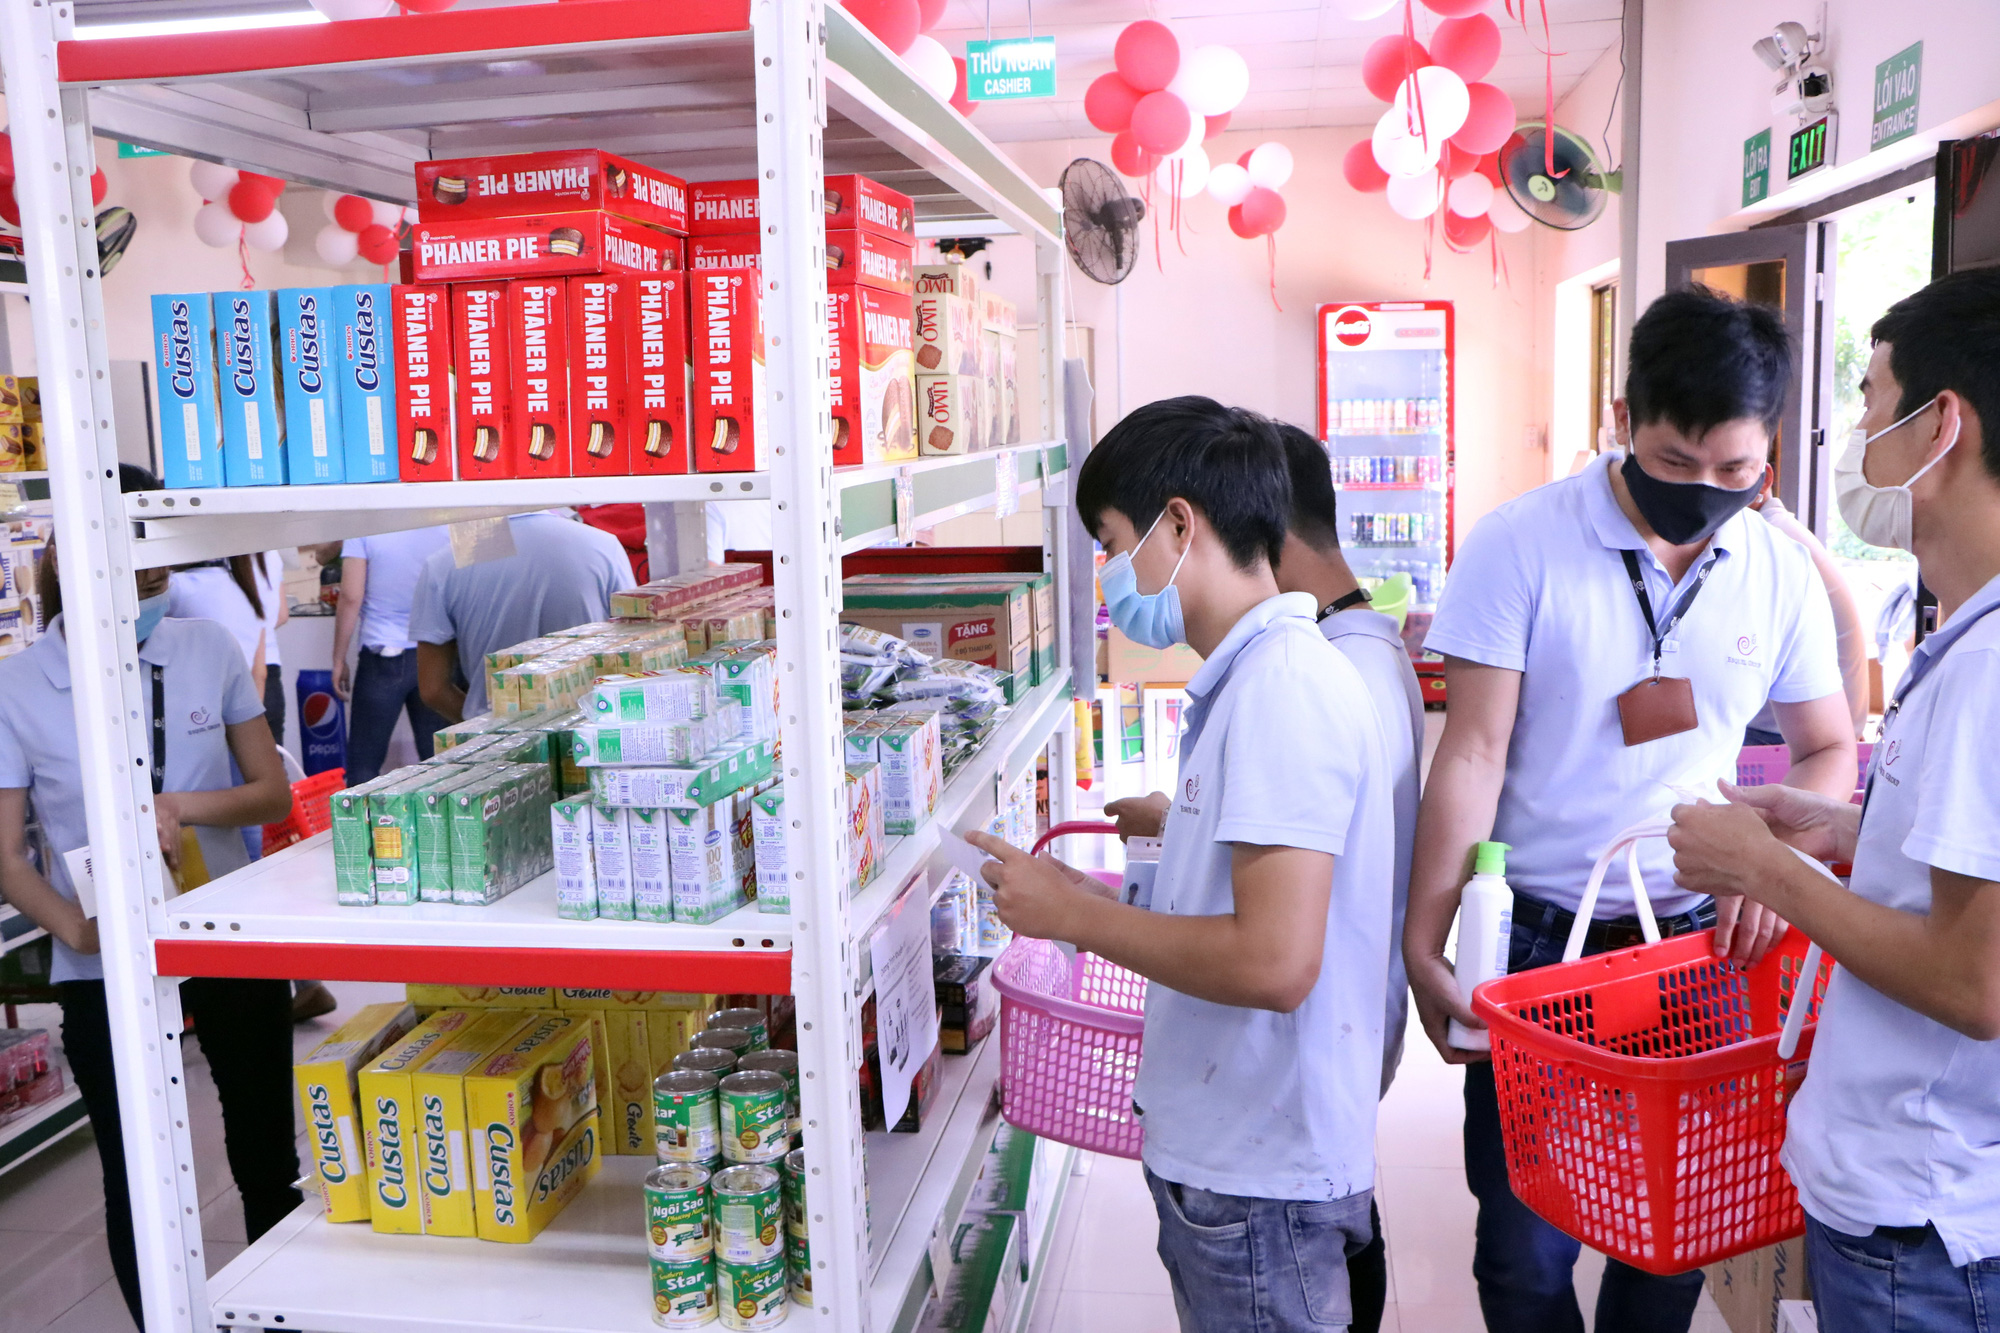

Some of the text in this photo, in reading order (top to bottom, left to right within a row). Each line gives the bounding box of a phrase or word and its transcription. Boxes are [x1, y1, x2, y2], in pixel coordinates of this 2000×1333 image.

[984, 77, 1032, 95] CASHIER
[1876, 61, 1915, 112] LỐI VÀO
[1872, 105, 1916, 144] ENTRANCE
[1758, 145, 1768, 167] RA
[1791, 124, 1826, 174] EXIT
[478, 167, 590, 196] PHANER PIE
[632, 172, 685, 214] PHANER PIE
[860, 194, 898, 230] PHANER PIE
[420, 237, 539, 266] PHANER PIE
[605, 234, 658, 271] PHANER PIE
[860, 248, 898, 282] PHANER PIE
[916, 278, 954, 294] LIMO
[864, 311, 900, 347] PHANER
[898, 318, 912, 348] PIE
[922, 300, 938, 342] LIMO
[162, 333, 170, 360] ORION
[171, 300, 196, 399] Custas
[224, 332, 232, 358] ORION
[232, 298, 258, 398] Custas
[298, 294, 323, 394] Custas
[354, 292, 380, 392] Custas
[405, 293, 431, 418] PHANER PIE
[467, 290, 492, 416] PHANER PIE
[524, 286, 549, 412] PHANER PIE
[584, 282, 608, 410] PHANER PIE
[640, 280, 666, 408] PHANER PIE
[707, 276, 732, 406] PHANER PIE
[933, 382, 950, 424] LIMO
[955, 623, 988, 638] TẶNG
[308, 744, 340, 756] pepsi
[484, 802, 499, 818] MILO
[380, 1031, 442, 1072] Custas
[513, 1017, 572, 1054] Custas
[508, 1099, 516, 1126] ORION
[654, 1106, 676, 1118] tar
[746, 1100, 772, 1115] Southern
[756, 1100, 786, 1124] Star
[308, 1084, 347, 1186] Custas
[366, 1130, 374, 1160] ORION
[378, 1096, 408, 1210] Custas
[424, 1094, 452, 1198] Custas
[486, 1122, 515, 1228] Custas
[538, 1126, 594, 1204] Custas
[320, 1183, 331, 1209] ORION
[424, 1194, 432, 1219] ORION
[653, 1198, 704, 1219] Ngôi Sao
[660, 1270, 684, 1280] Southern
[666, 1272, 705, 1291] Star
[744, 1270, 770, 1285] Southern
[752, 1267, 784, 1294] Star
